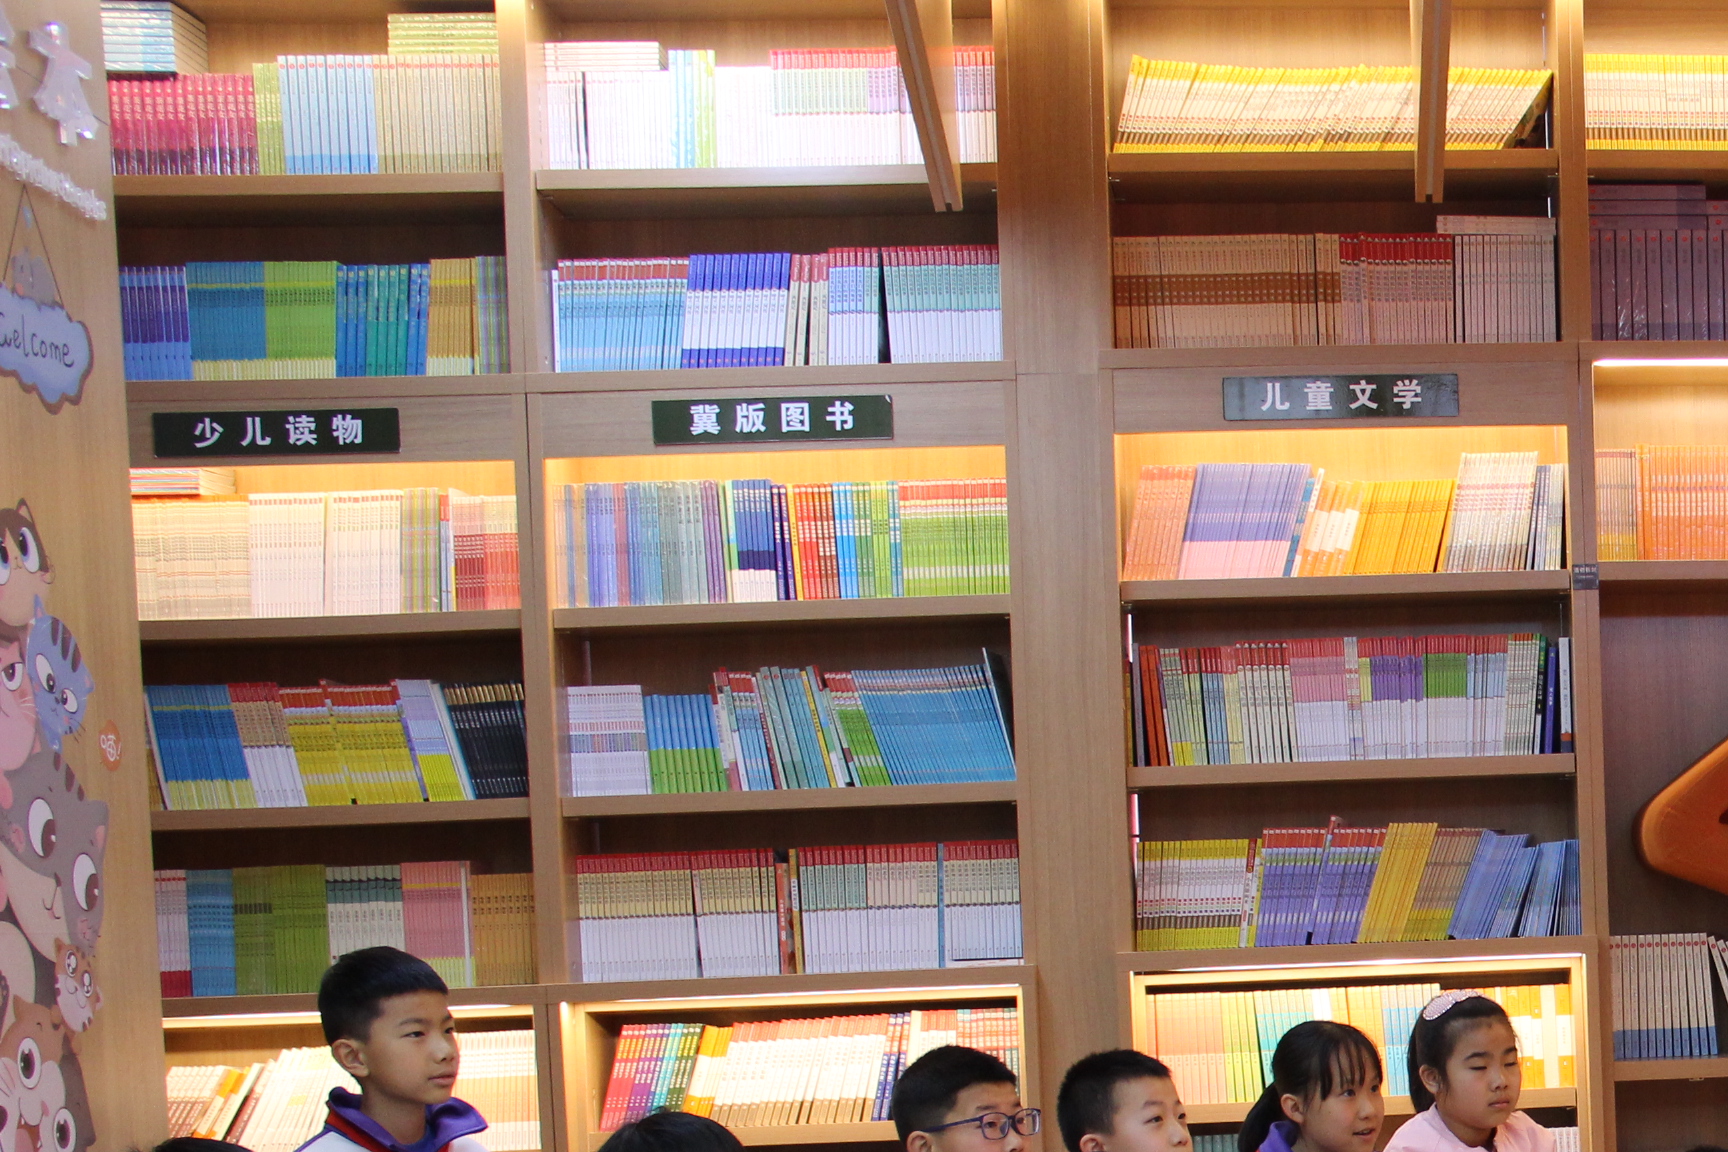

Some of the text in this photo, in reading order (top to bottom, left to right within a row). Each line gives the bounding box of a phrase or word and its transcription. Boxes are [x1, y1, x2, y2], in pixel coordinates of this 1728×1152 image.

[1261, 380, 1422, 411] 儿童文学
[194, 414, 363, 448] 少儿读物
[690, 401, 854, 435] 冀版图书
